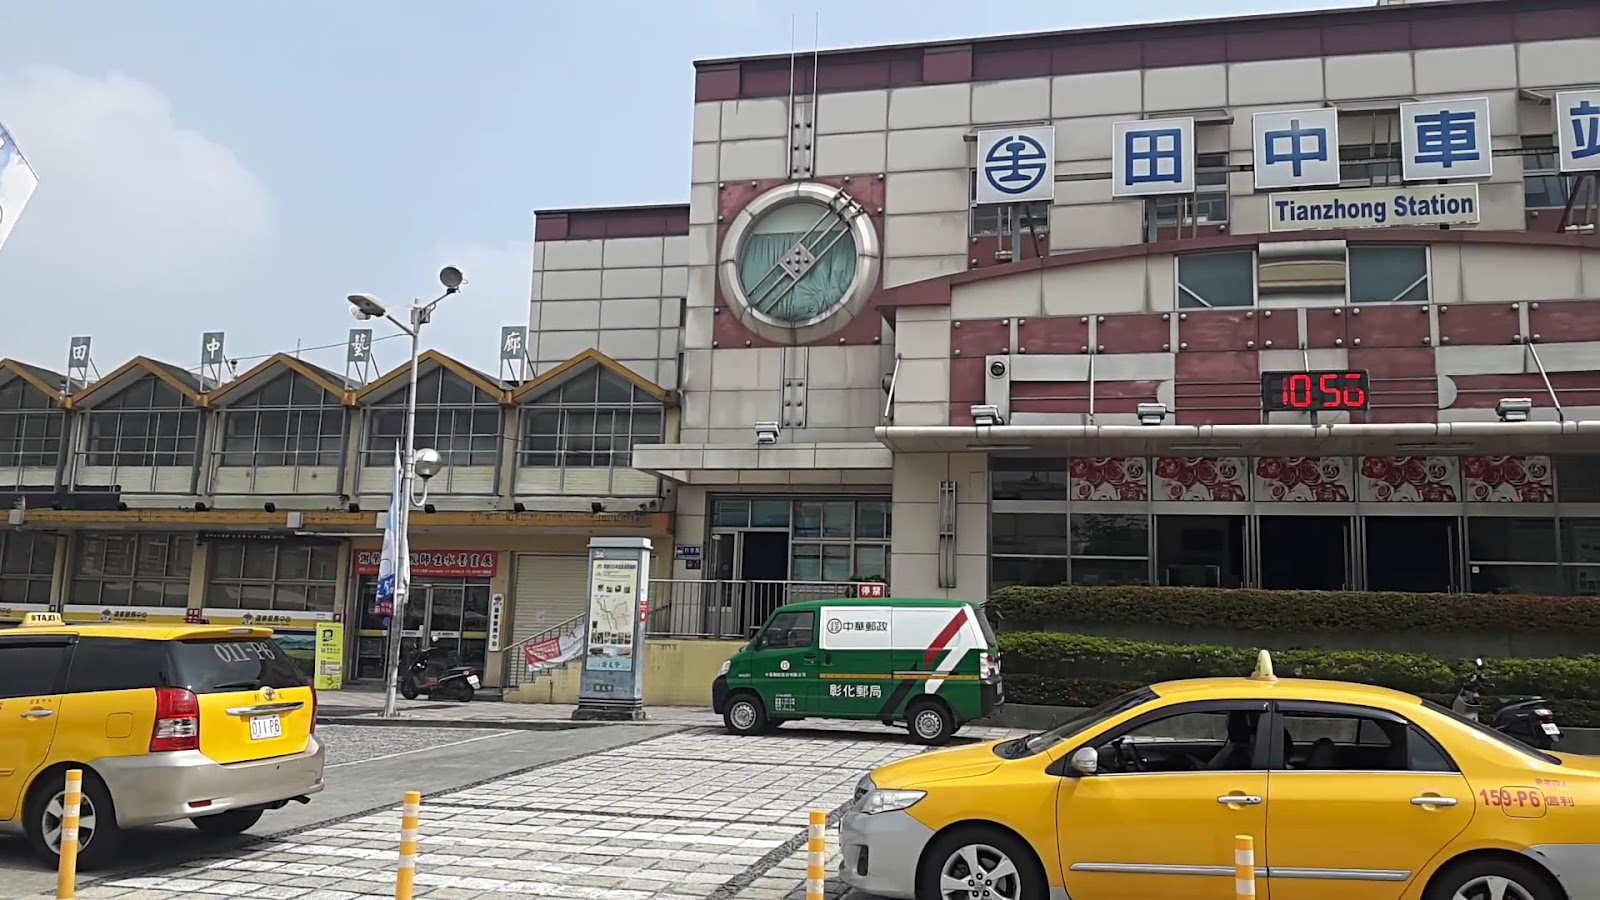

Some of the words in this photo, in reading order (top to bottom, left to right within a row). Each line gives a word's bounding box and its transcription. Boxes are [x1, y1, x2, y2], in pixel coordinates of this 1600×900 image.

[1275, 198, 1386, 223] Tianzhong
[1394, 194, 1474, 217] Station
[843, 621, 888, 632] 中華郵政
[214, 642, 276, 663] 011-P6
[829, 684, 882, 698] 彰化郵局
[1480, 789, 1540, 807] 159-P6
